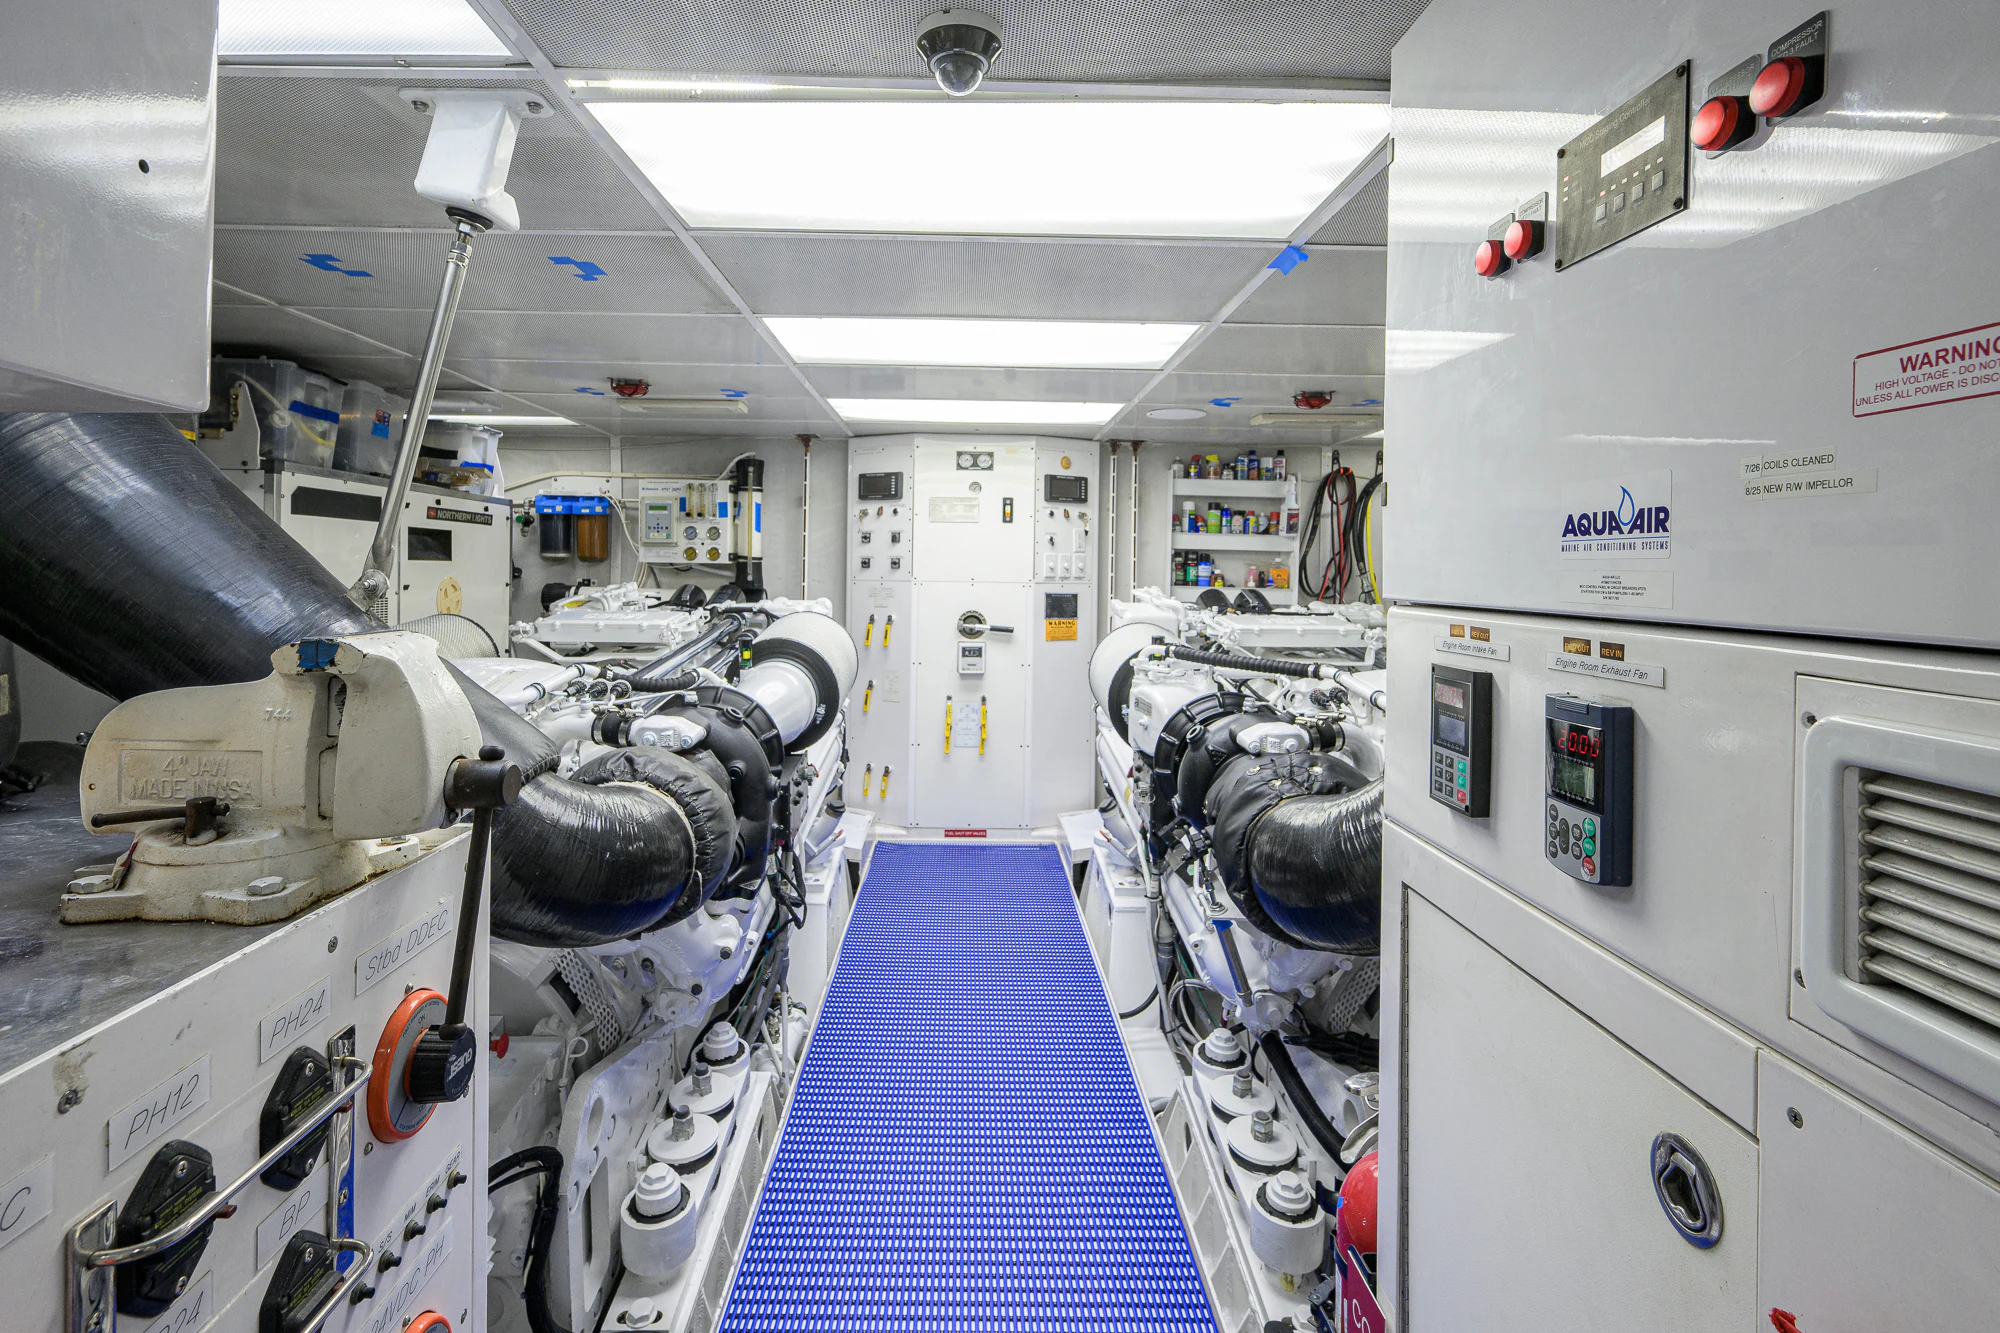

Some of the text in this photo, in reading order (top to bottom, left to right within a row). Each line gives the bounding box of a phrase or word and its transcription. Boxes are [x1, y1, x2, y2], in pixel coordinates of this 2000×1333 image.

[1771, 20, 1823, 57] COMPRESSOR
[1795, 31, 1819, 52] FAULT
[1620, 96, 1652, 123] Controller
[1875, 379, 1899, 391] HIGH
[1902, 368, 1949, 386] VOLTAGE
[1958, 364, 1976, 375] DO
[1855, 392, 1892, 406] UNLESS
[1894, 390, 1912, 400] ALL
[1914, 381, 1954, 396] POWER
[1958, 379, 1968, 388] IS
[1744, 454, 1834, 473] 7/26 COILS CLEANED
[1745, 478, 1854, 496] 8/25 NEW R/W IMPELLOR
[437, 510, 492, 524] NORTHERN LIGHTS
[1562, 506, 1670, 538] AQUA AIR
[1562, 540, 1668, 552] MARINE AIR CONDITIONING SYSTEMS
[1442, 641, 1497, 655] Engine Room Intake Fan
[1602, 648, 1622, 658] REV IN
[1555, 658, 1648, 680] Engine Room Exhaust Fan
[189, 756, 230, 777] JAW
[130, 778, 187, 800] MADE
[213, 779, 255, 800] USA
[366, 910, 448, 980] Stbd DDEC
[268, 988, 326, 1049] PH24
[418, 1013, 426, 1024] ON
[446, 1048, 472, 1082] GUEST
[124, 1074, 200, 1150] PH12
[445, 1151, 460, 1174] GEAR
[0, 1186, 30, 1232] C
[278, 1190, 310, 1240] BP
[424, 1235, 445, 1276] PH
[159, 1290, 204, 1333] 24
